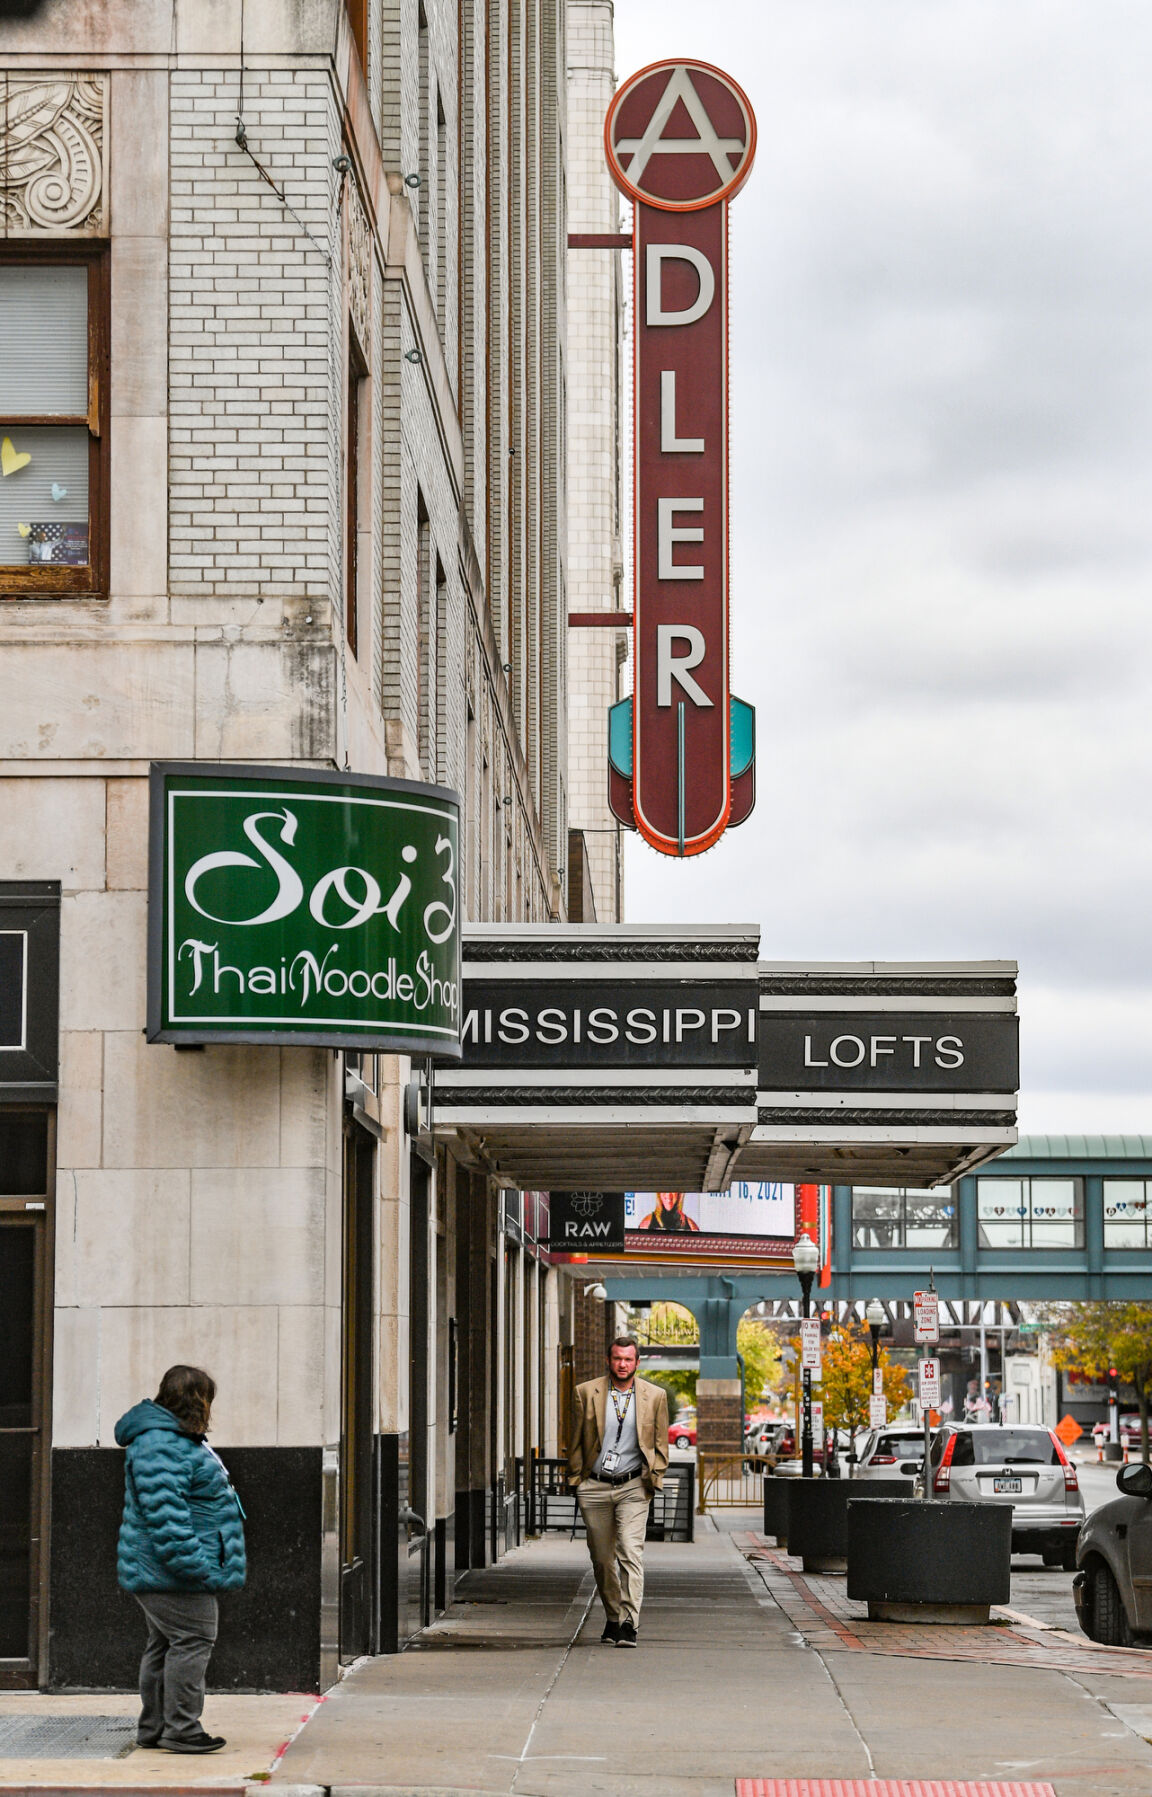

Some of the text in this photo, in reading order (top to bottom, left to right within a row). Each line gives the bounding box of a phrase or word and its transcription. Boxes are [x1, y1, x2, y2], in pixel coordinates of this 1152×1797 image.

[614, 65, 746, 707] ADLER
[184, 806, 456, 944] Soi 3
[178, 938, 458, 1021] Thai Noodle Shop
[803, 1034, 966, 1070] LOFTS
[565, 1221, 612, 1237] RAW
